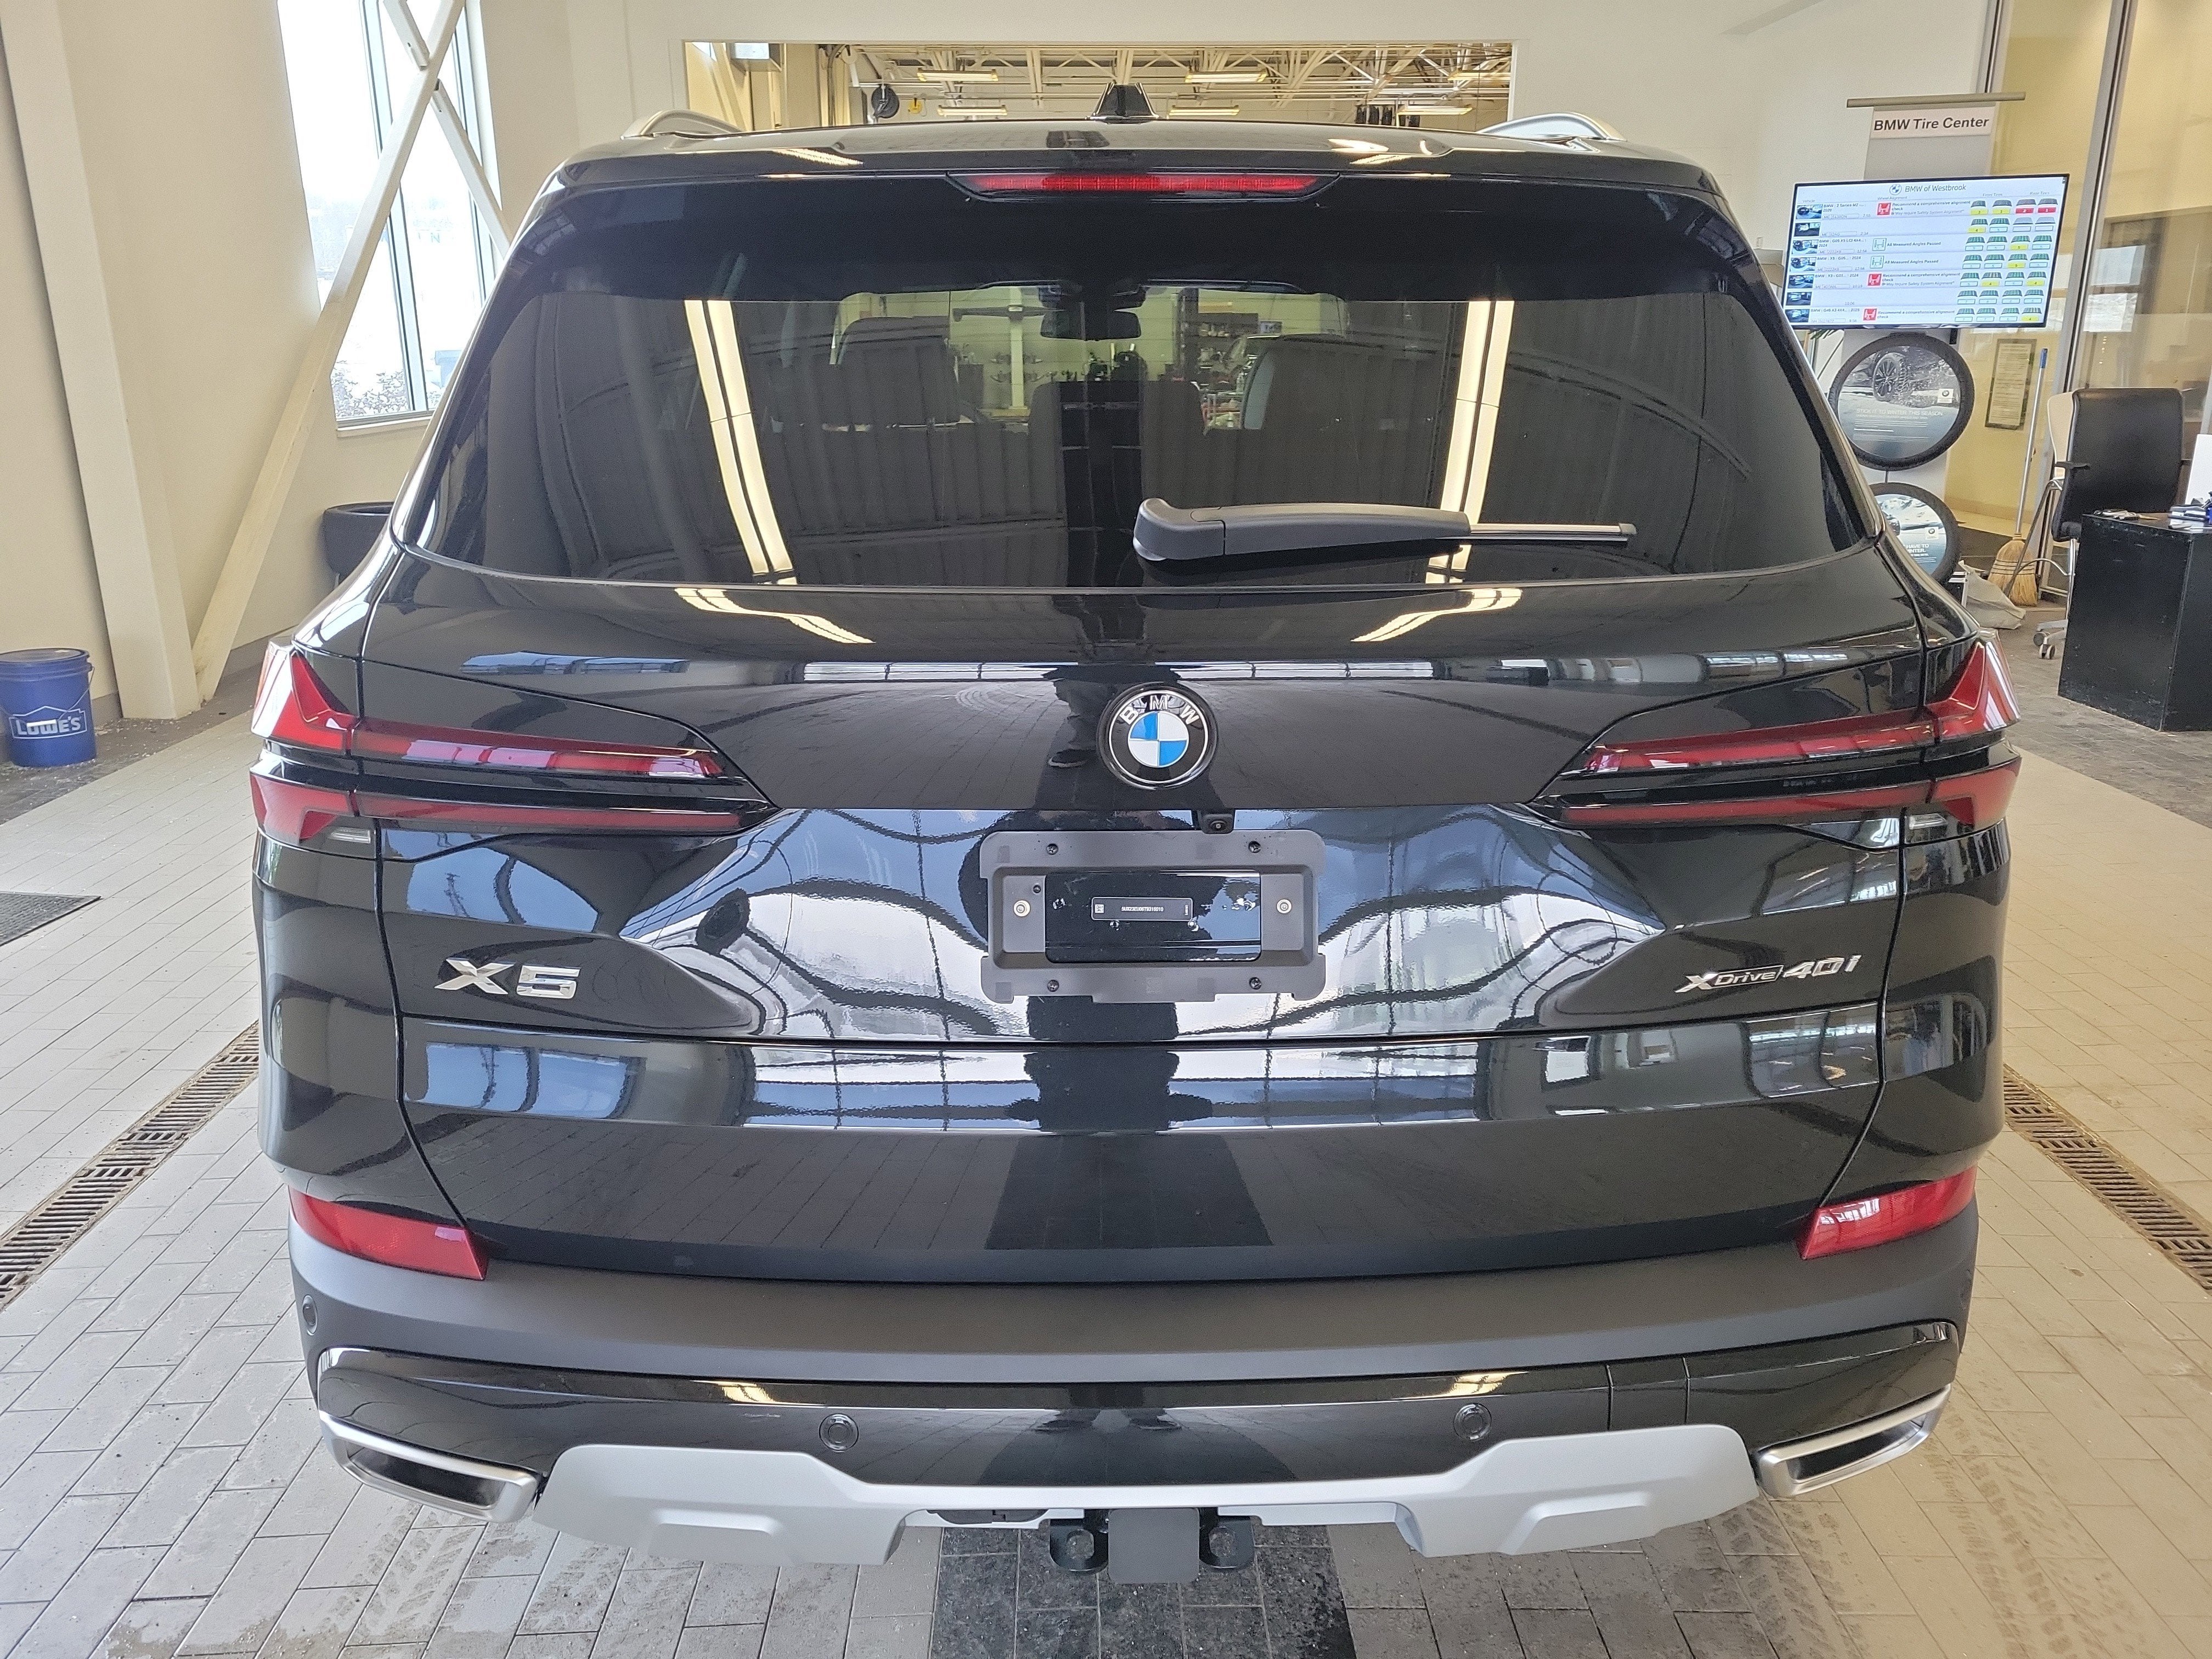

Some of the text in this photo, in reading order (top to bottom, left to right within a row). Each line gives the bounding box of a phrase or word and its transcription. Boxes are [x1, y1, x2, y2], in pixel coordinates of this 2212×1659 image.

[1874, 117, 1989, 131] BMW Tire Center
[1119, 695, 1200, 725] BMW
[15, 716, 82, 735] LOWE'S
[434, 957, 583, 1000] X5
